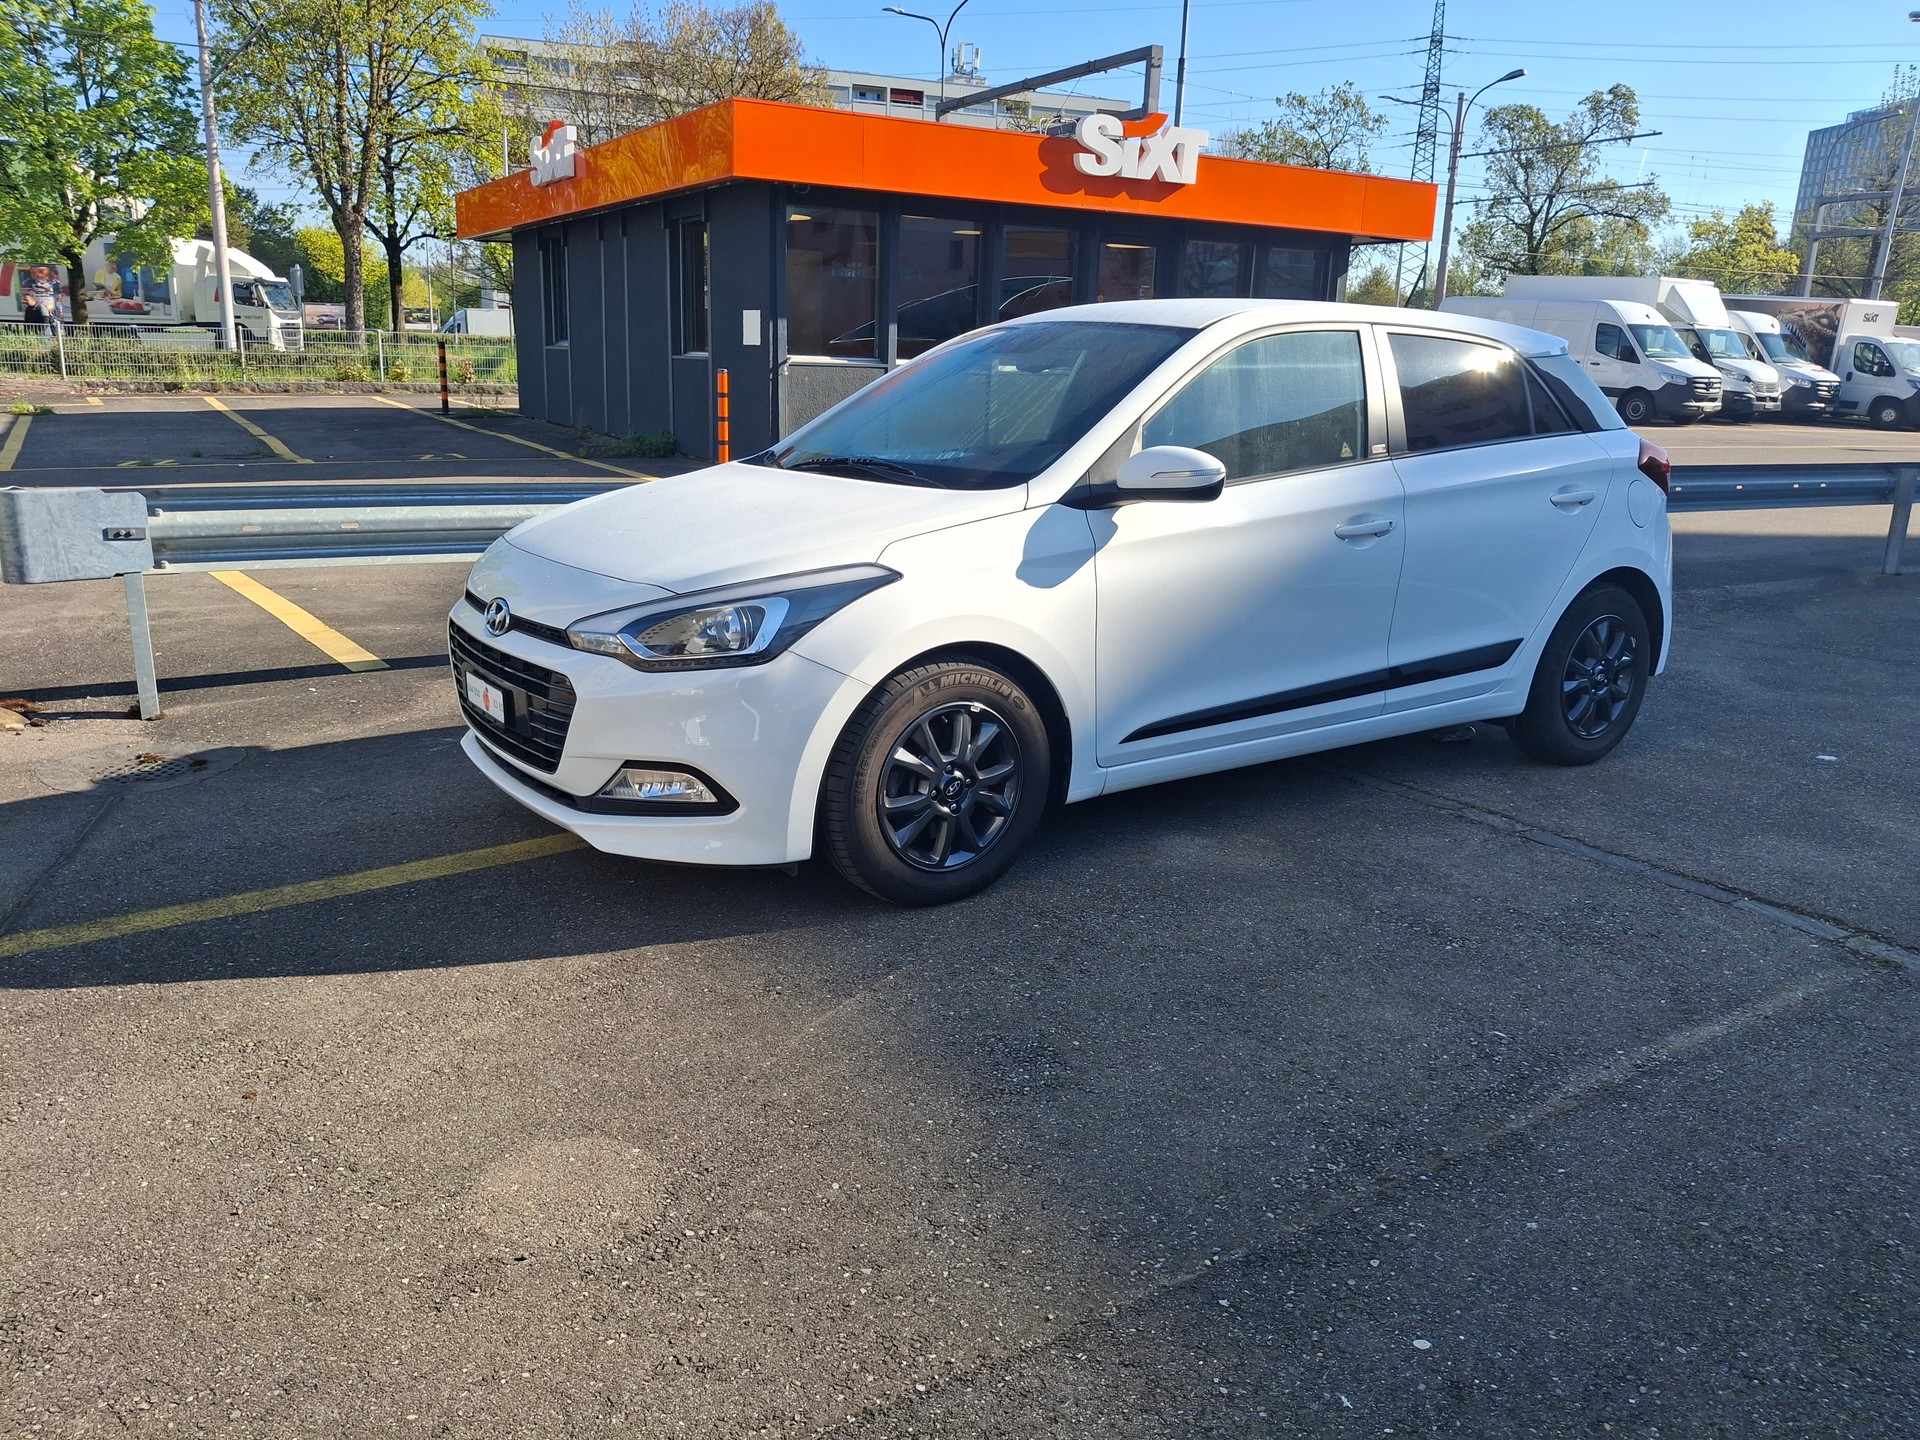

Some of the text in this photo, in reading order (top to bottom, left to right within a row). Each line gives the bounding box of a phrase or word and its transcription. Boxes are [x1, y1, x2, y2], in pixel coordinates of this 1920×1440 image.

[1073, 112, 1209, 184] SIXT
[1863, 312, 1880, 323] SIXT
[940, 673, 1012, 697] MICHELIN
